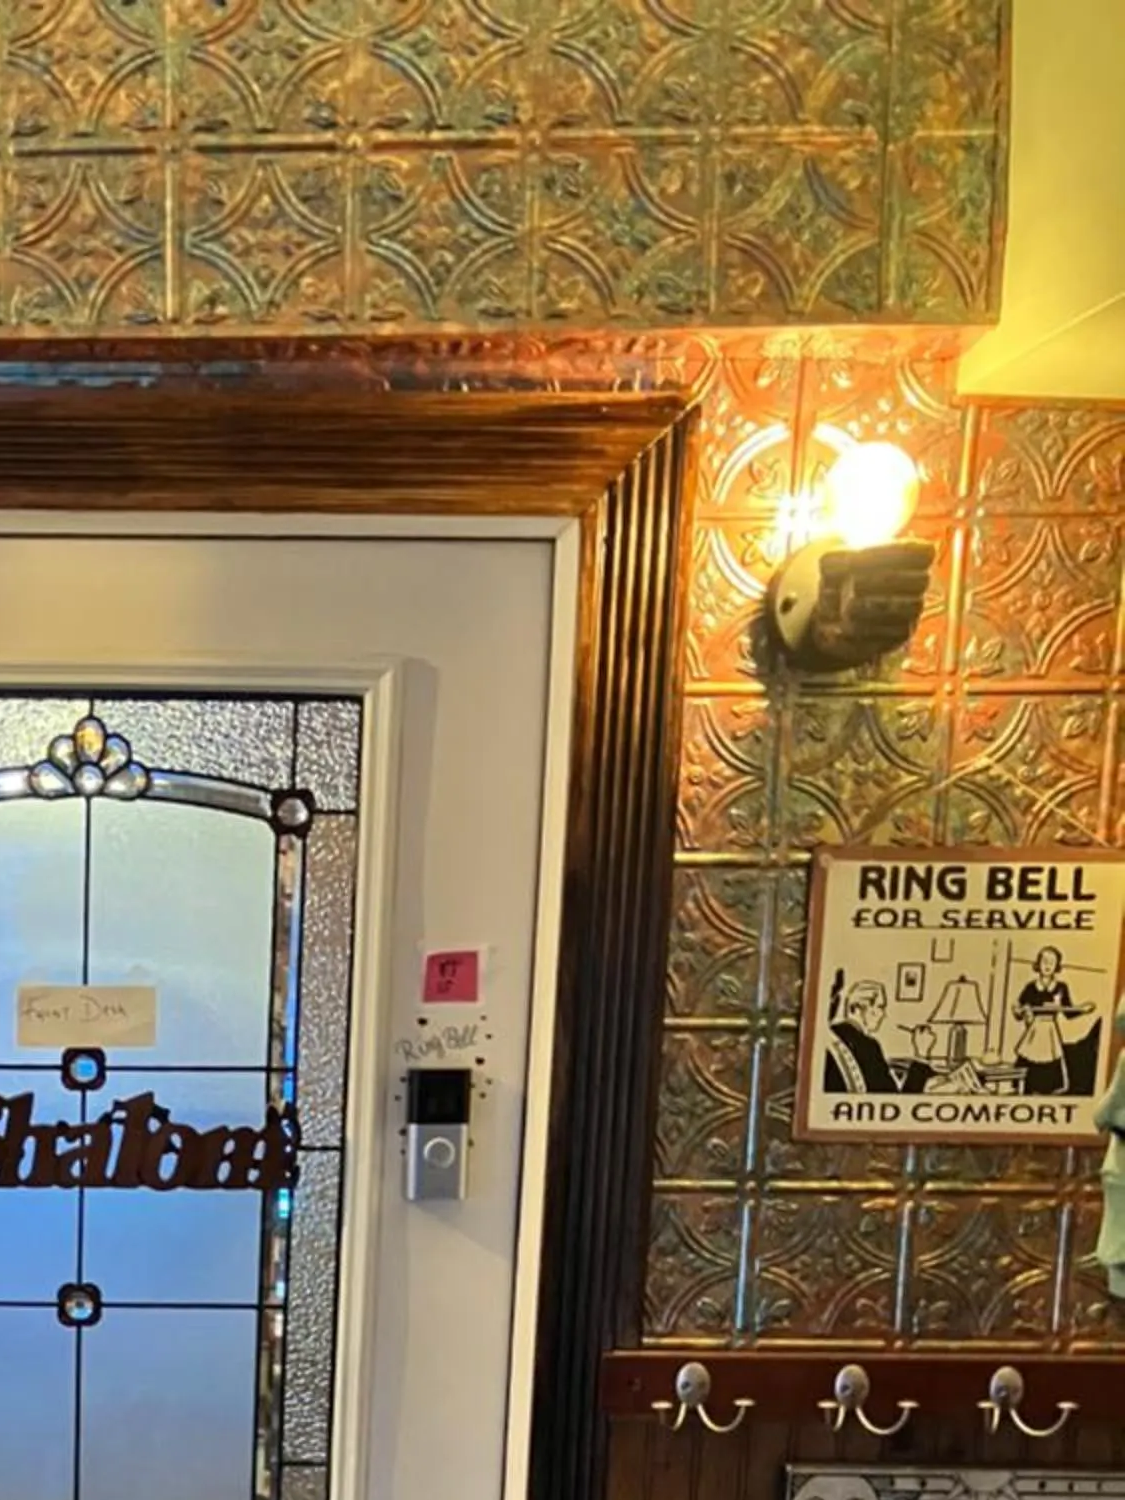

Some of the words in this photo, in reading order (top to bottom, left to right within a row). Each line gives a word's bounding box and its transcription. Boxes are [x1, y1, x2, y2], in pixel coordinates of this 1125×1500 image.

[858, 864, 967, 902] RING
[986, 865, 1097, 902] BELL
[851, 907, 924, 929] FOR
[940, 908, 1096, 931] SERVICE
[395, 1035, 446, 1064] Ring
[443, 1024, 479, 1050] Bell
[830, 1100, 901, 1123] AND
[911, 1101, 1078, 1124] COMFORT
